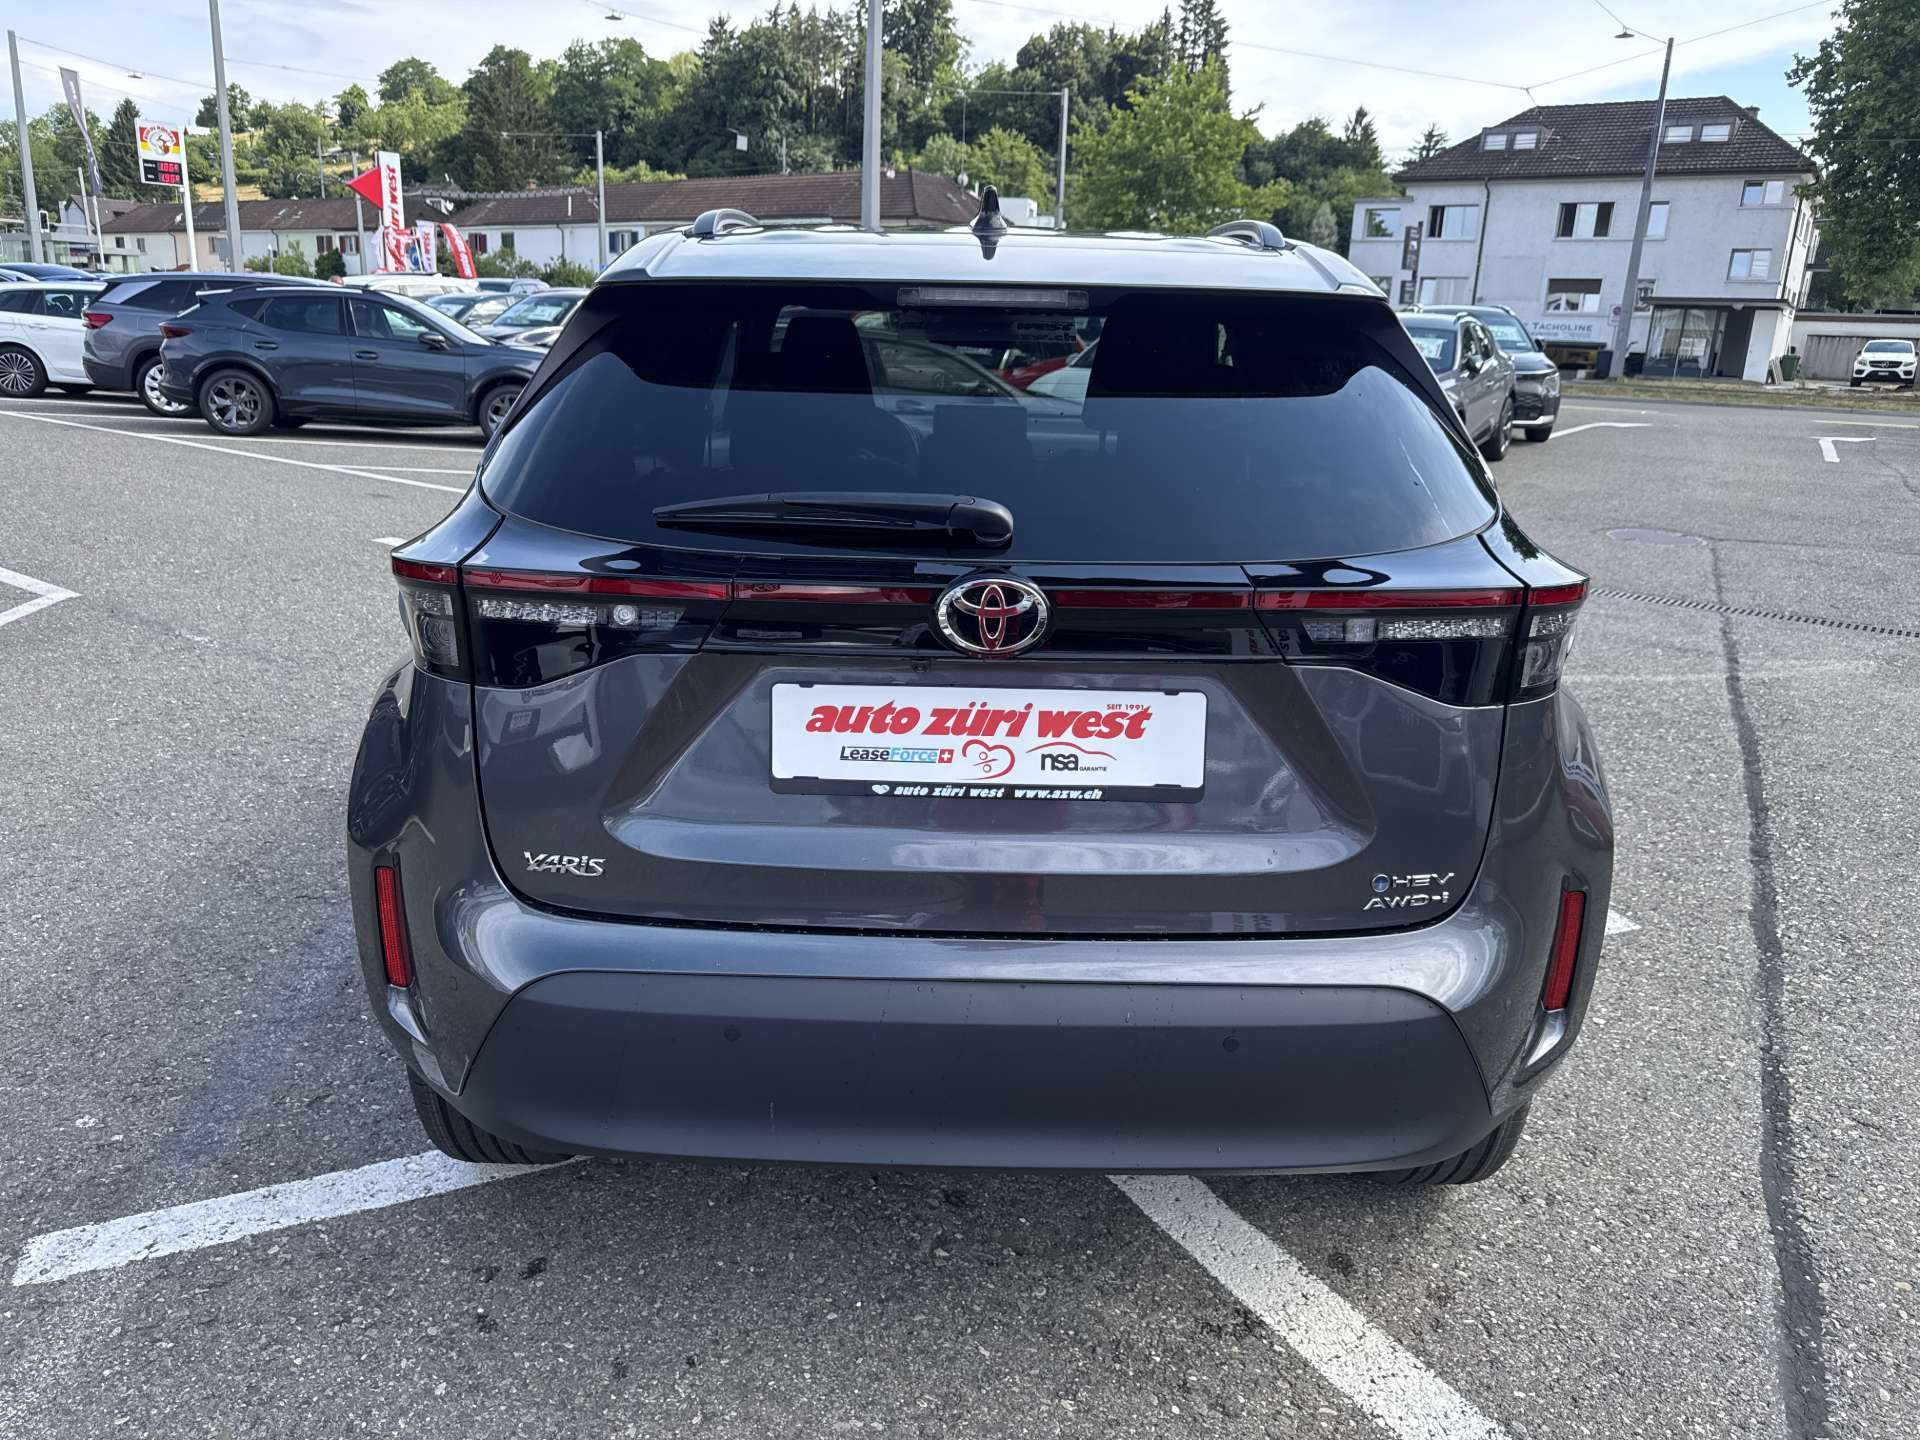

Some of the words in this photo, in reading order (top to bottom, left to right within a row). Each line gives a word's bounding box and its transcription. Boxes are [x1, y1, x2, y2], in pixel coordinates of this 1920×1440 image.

[1532, 321, 1593, 332] TACHOLINE
[1106, 703, 1123, 711] SEIT
[1124, 703, 1145, 711] 1991
[804, 699, 921, 735] auto
[921, 701, 1034, 738] züri
[1037, 704, 1153, 740] west
[839, 745, 939, 763] LeaseForce
[1040, 752, 1079, 772] nsa
[893, 785, 929, 796] auto
[969, 786, 1005, 798] west
[1014, 787, 1103, 800] www.azw.ch
[1391, 872, 1455, 888] HEV
